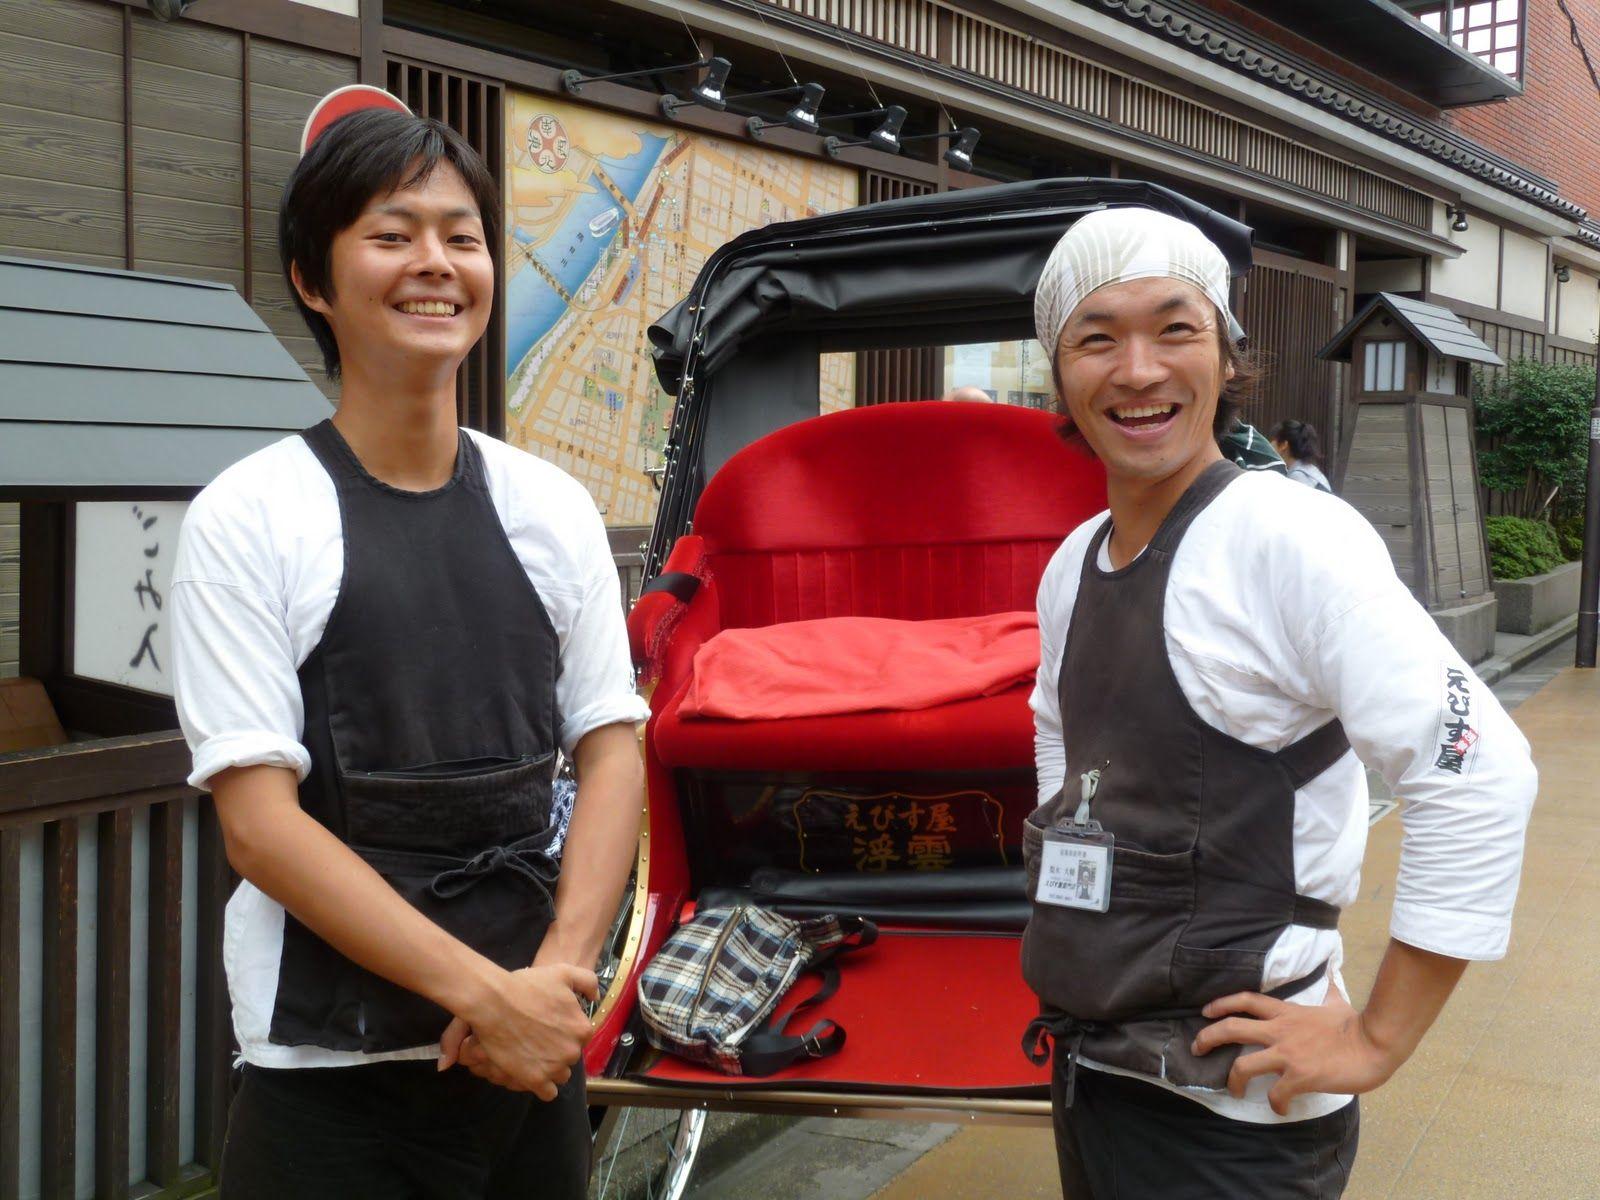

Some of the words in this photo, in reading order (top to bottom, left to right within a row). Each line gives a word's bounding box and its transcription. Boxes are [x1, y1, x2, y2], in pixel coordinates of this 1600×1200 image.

[1435, 667, 1470, 774] えびす屋
[844, 803, 956, 832] えびす屋
[853, 835, 953, 872] 浮雲
